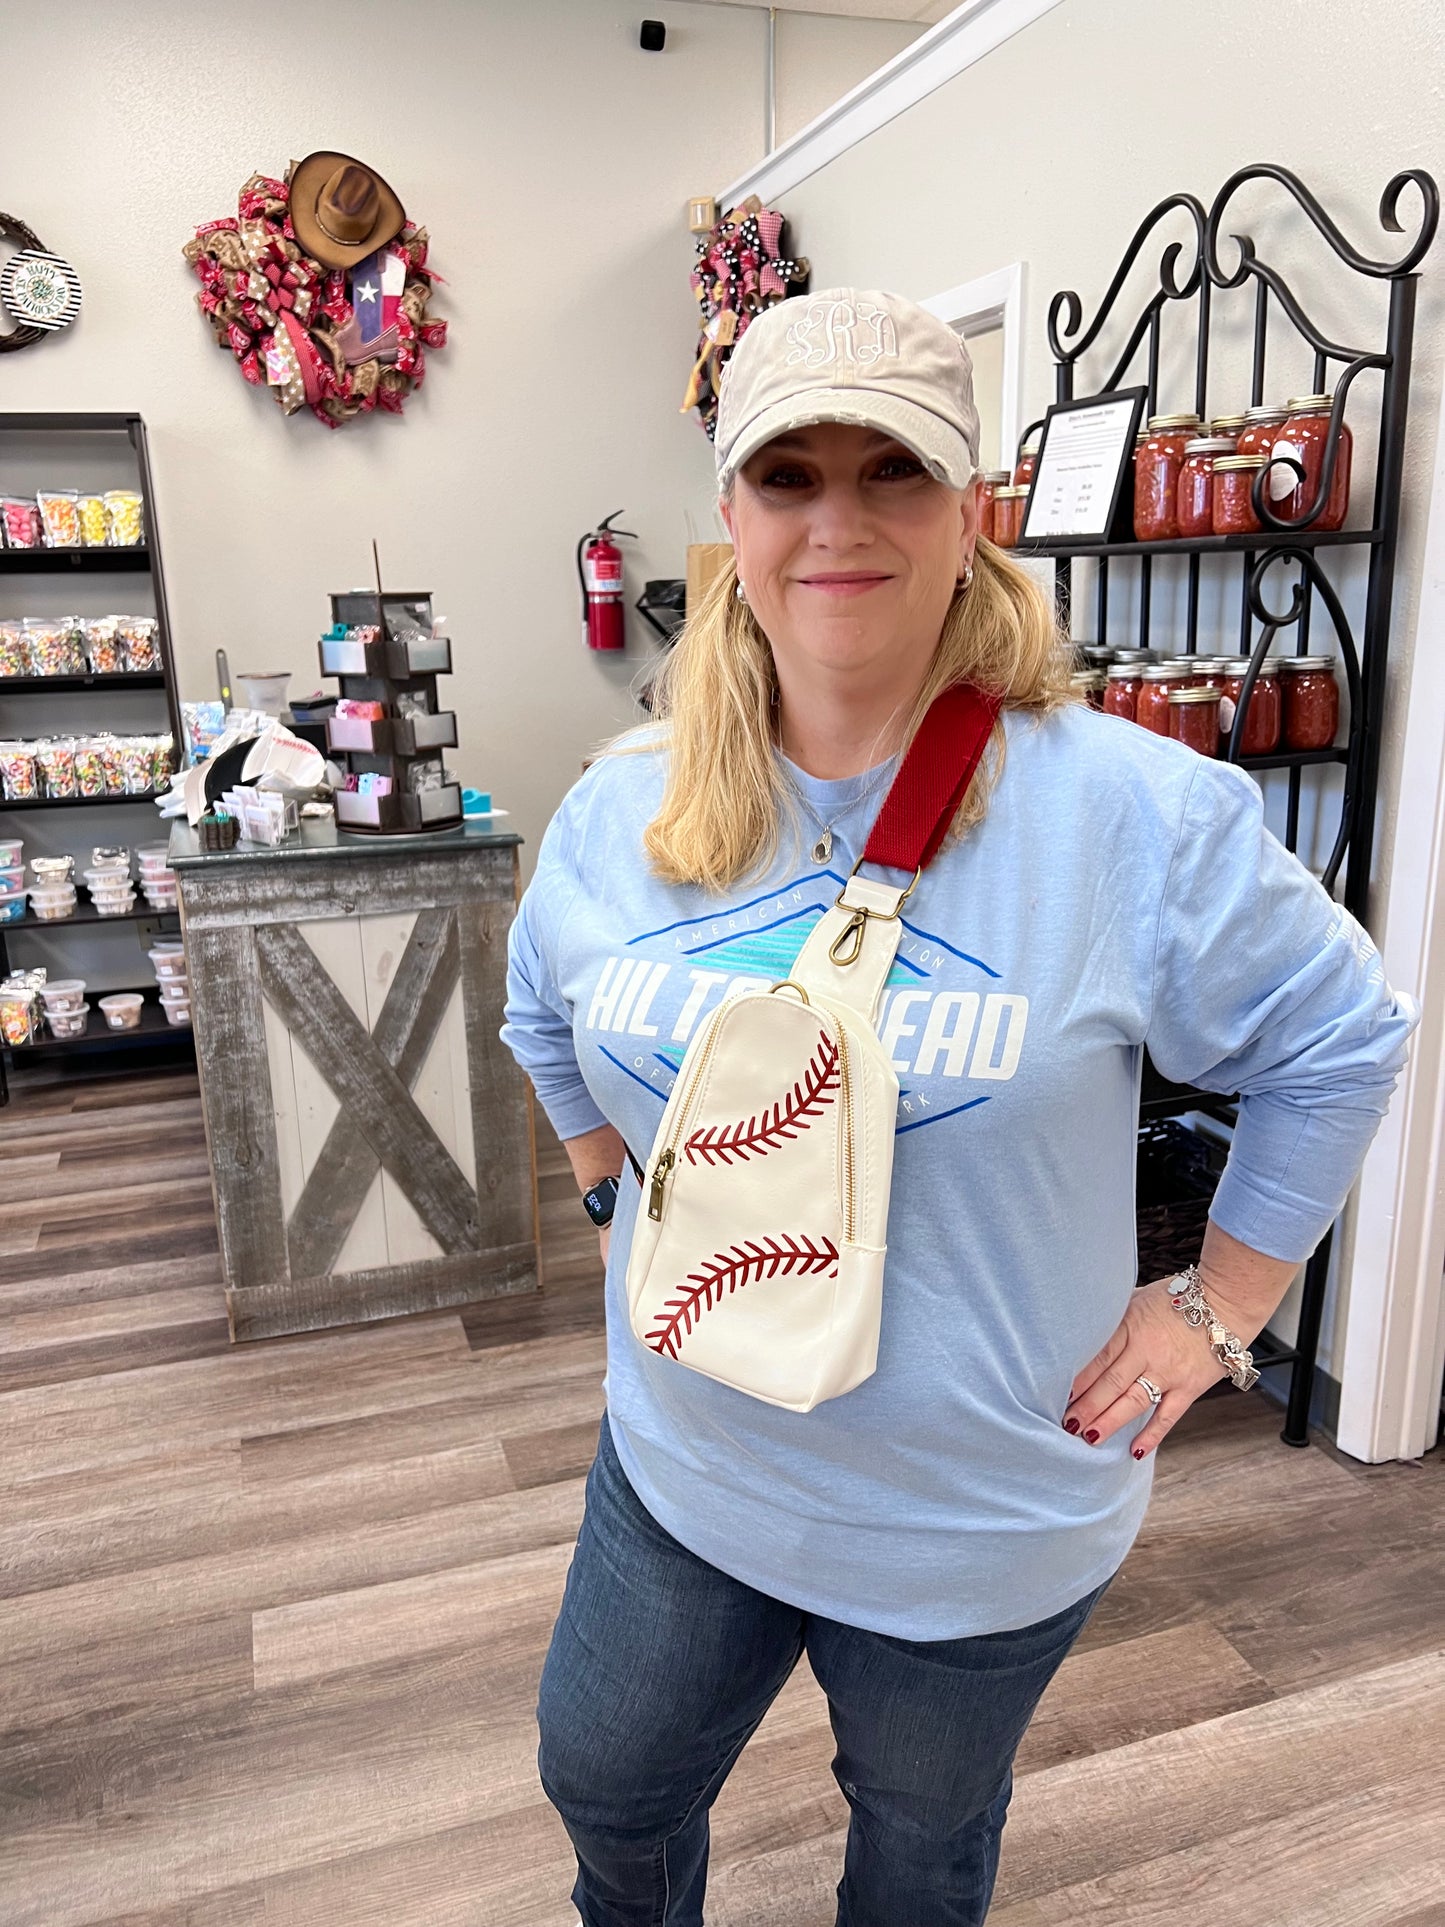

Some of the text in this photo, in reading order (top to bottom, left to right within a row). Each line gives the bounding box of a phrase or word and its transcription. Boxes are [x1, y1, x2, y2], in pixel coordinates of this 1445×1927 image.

[26, 265, 58, 280] HAPPY
[674, 889, 802, 949] AMERICAN
[585, 956, 775, 1042] HILT
